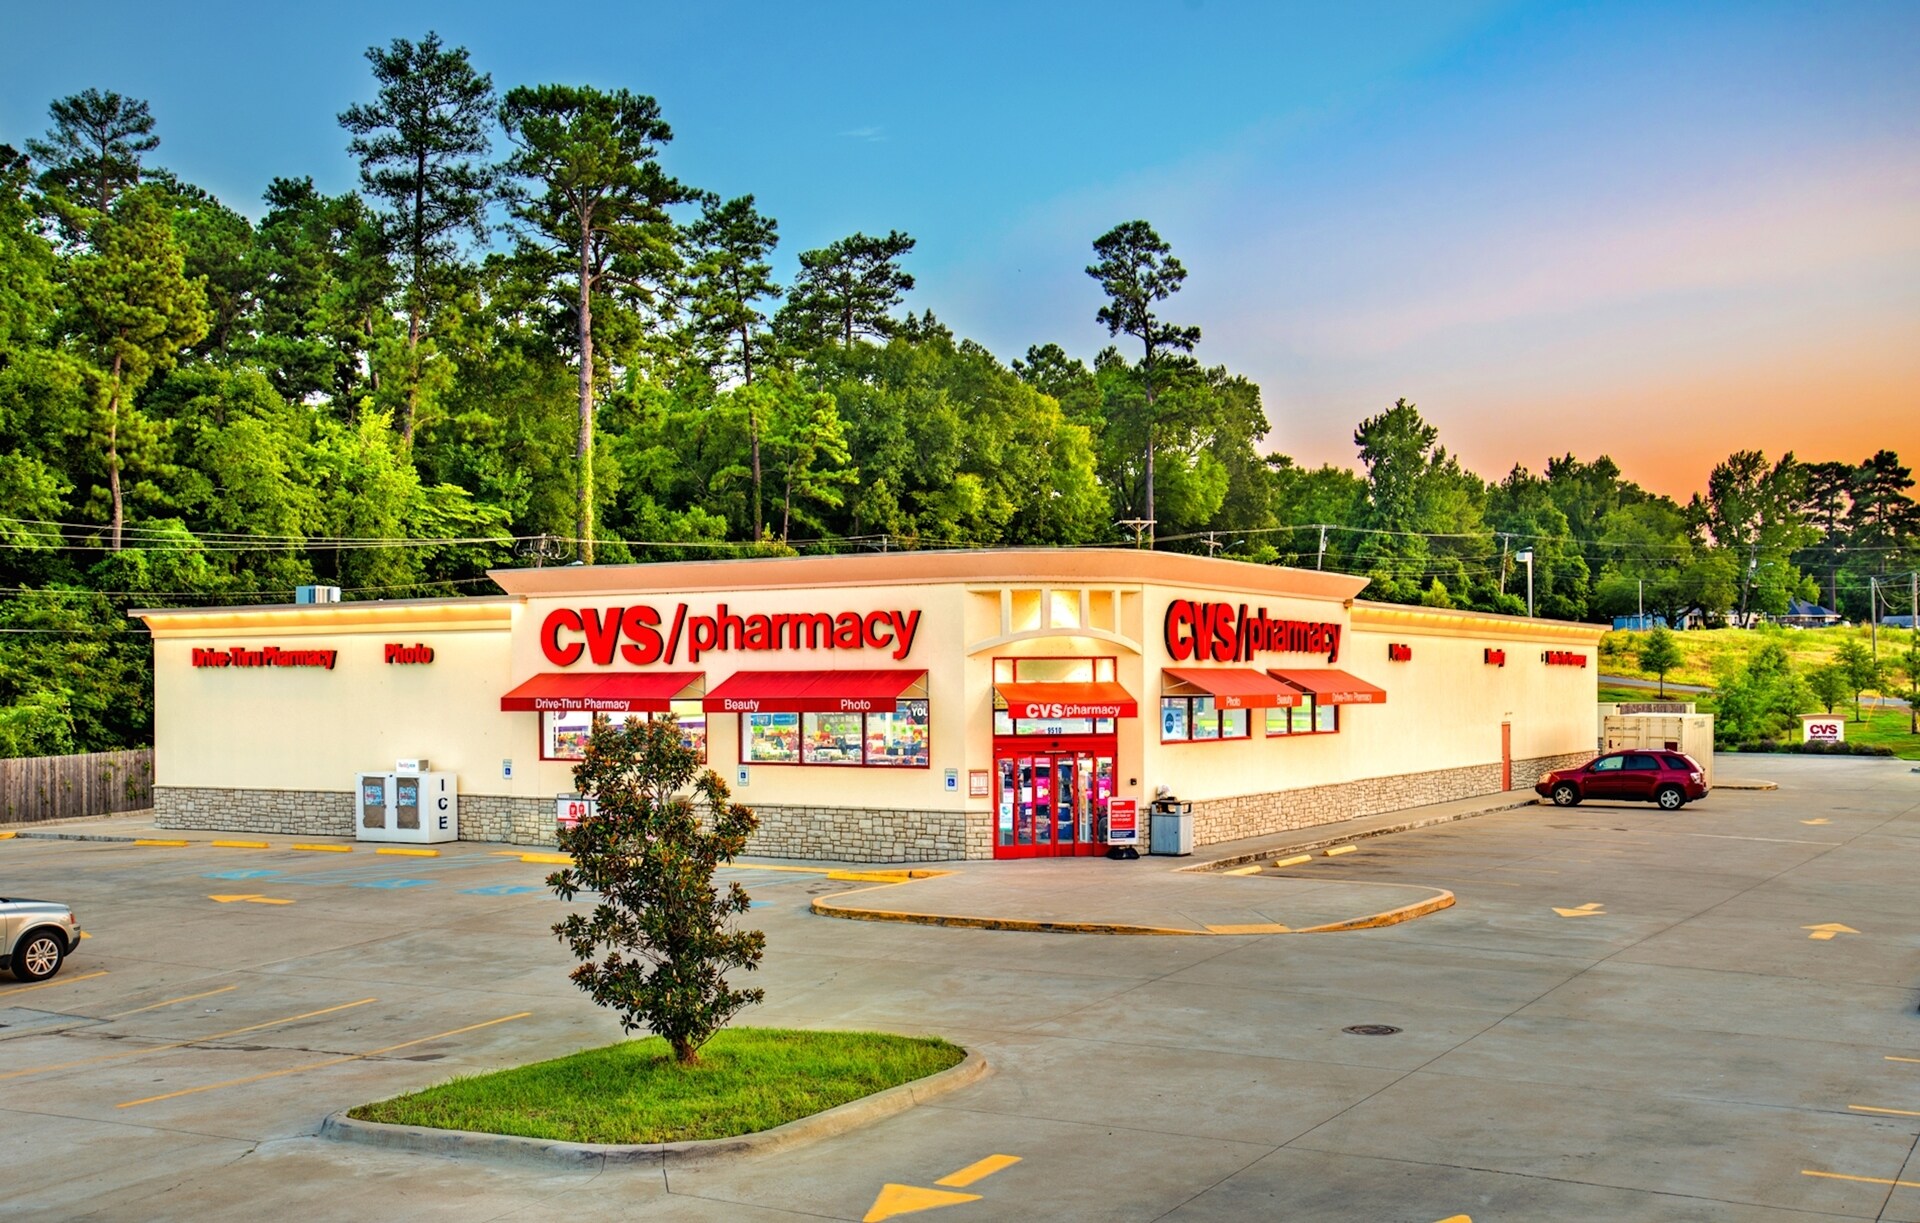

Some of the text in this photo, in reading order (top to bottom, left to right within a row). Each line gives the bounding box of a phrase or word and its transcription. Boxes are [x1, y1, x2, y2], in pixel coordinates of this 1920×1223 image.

[540, 603, 922, 667] CVS/pharmacy
[1164, 600, 1342, 664] CVS/pharmacy
[264, 647, 337, 670] Pharmacy
[385, 643, 434, 664] Photo
[535, 698, 631, 712] Drive-Thru Pharmacy
[724, 699, 760, 712] Beauty
[841, 699, 870, 711] Photo
[1226, 696, 1241, 706] Photo
[1026, 704, 1120, 718] CVS/pharmacy
[1810, 724, 1837, 734] CVS
[438, 779, 448, 829] ICE
